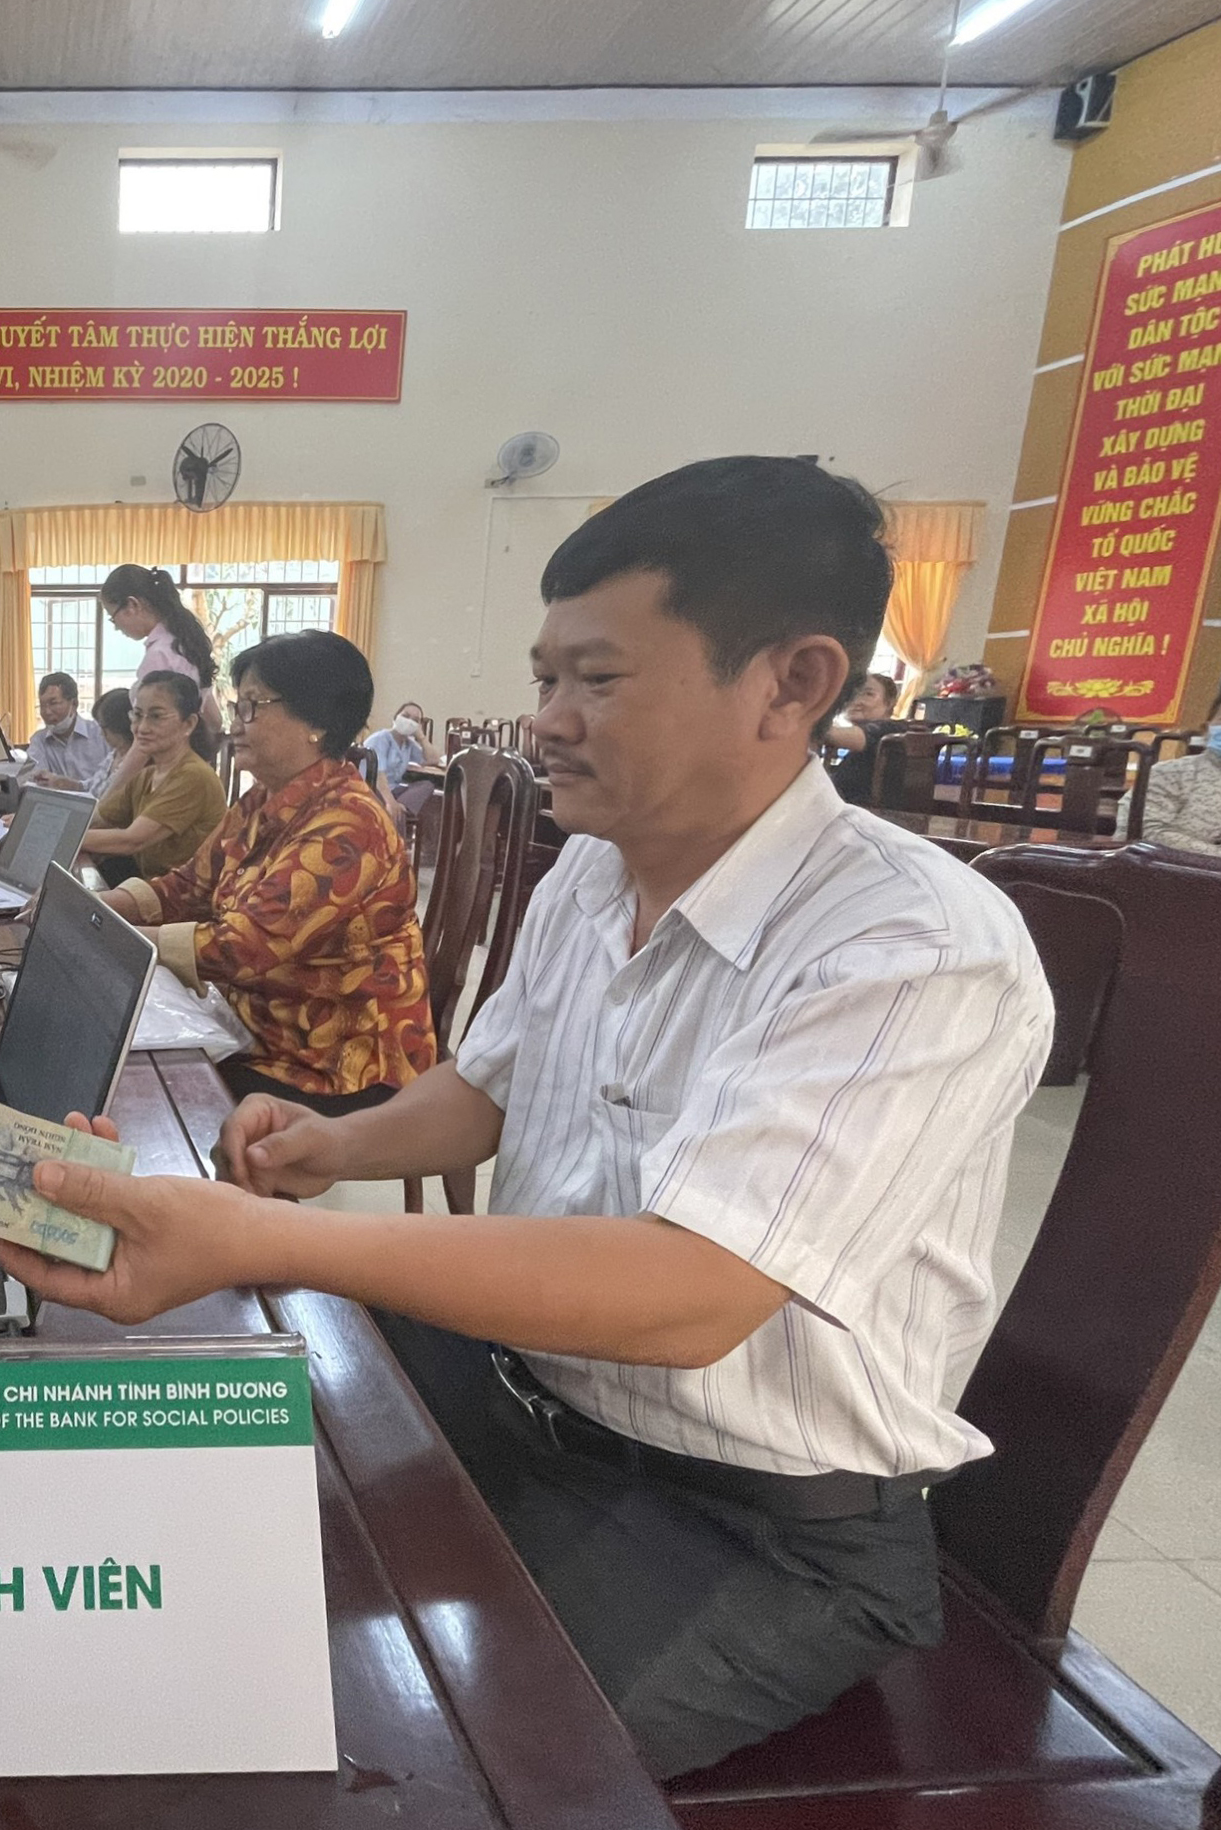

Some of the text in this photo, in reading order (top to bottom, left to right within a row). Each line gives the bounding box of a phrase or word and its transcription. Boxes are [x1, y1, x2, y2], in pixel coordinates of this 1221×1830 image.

[1137, 241, 1195, 278] PHÁT
[1124, 270, 1221, 316] SỨC MẠN
[68, 320, 120, 348] TÂM
[126, 322, 191, 353] THỰC
[197, 320, 256, 353] HIỆN
[262, 315, 343, 349] THẮNG
[349, 324, 388, 354] LỢI
[1127, 306, 1221, 350] DÂN TỘC
[28, 360, 106, 393] NHIỆM
[112, 360, 145, 388] KỲ
[152, 366, 208, 389] 2020
[230, 366, 285, 389] 2025
[292, 366, 299, 389] !
[1093, 363, 1126, 392] VỚI
[1129, 353, 1172, 384] SỨC
[1114, 383, 1206, 421] THỜI ĐẠI
[1099, 419, 1206, 457] XÂY DỰNG
[1093, 452, 1200, 492] VÀ BẢO VỆ
[1081, 486, 1198, 526] VỮNG CHẮC
[1120, 524, 1177, 557] QUỐC
[1075, 565, 1173, 595] VIỆT NAM
[1081, 597, 1150, 627] XÃ HỘI
[1049, 631, 1171, 659] CHỦ NGHĨA !
[3, 1385, 38, 1402] CHI
[44, 1382, 112, 1402] NHÁNH
[166, 1380, 210, 1400] BÌNH
[15, 1412, 44, 1428] THE
[50, 1411, 98, 1428] BANK
[104, 1410, 138, 1427] FOR
[142, 1409, 208, 1426] SOCIAL
[213, 1408, 290, 1425] POLICIES
[42, 1557, 162, 1611] VIÊN
